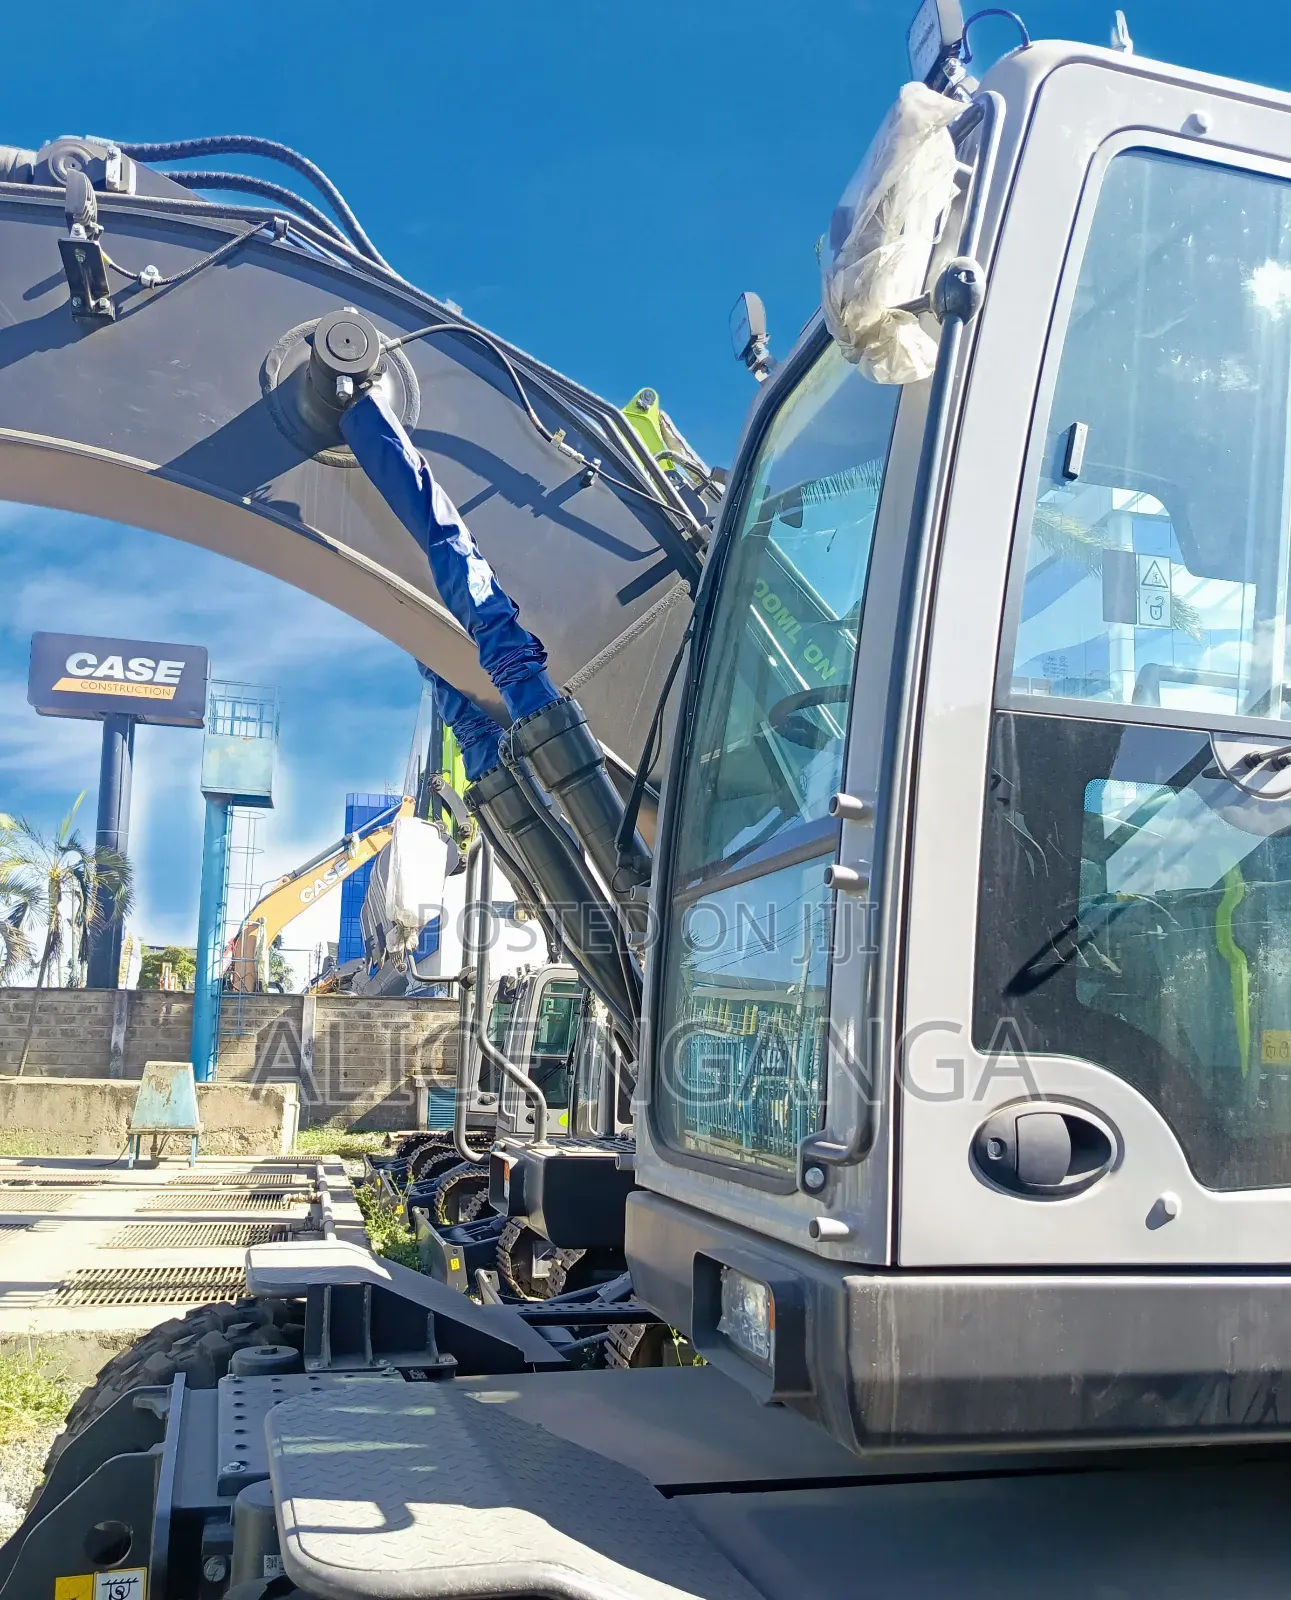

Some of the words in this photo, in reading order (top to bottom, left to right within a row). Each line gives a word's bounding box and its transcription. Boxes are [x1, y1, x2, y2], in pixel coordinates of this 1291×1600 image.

[65, 652, 186, 684] CASE
[80, 679, 171, 697] CONSTRUCTION
[299, 857, 350, 904] CASE
